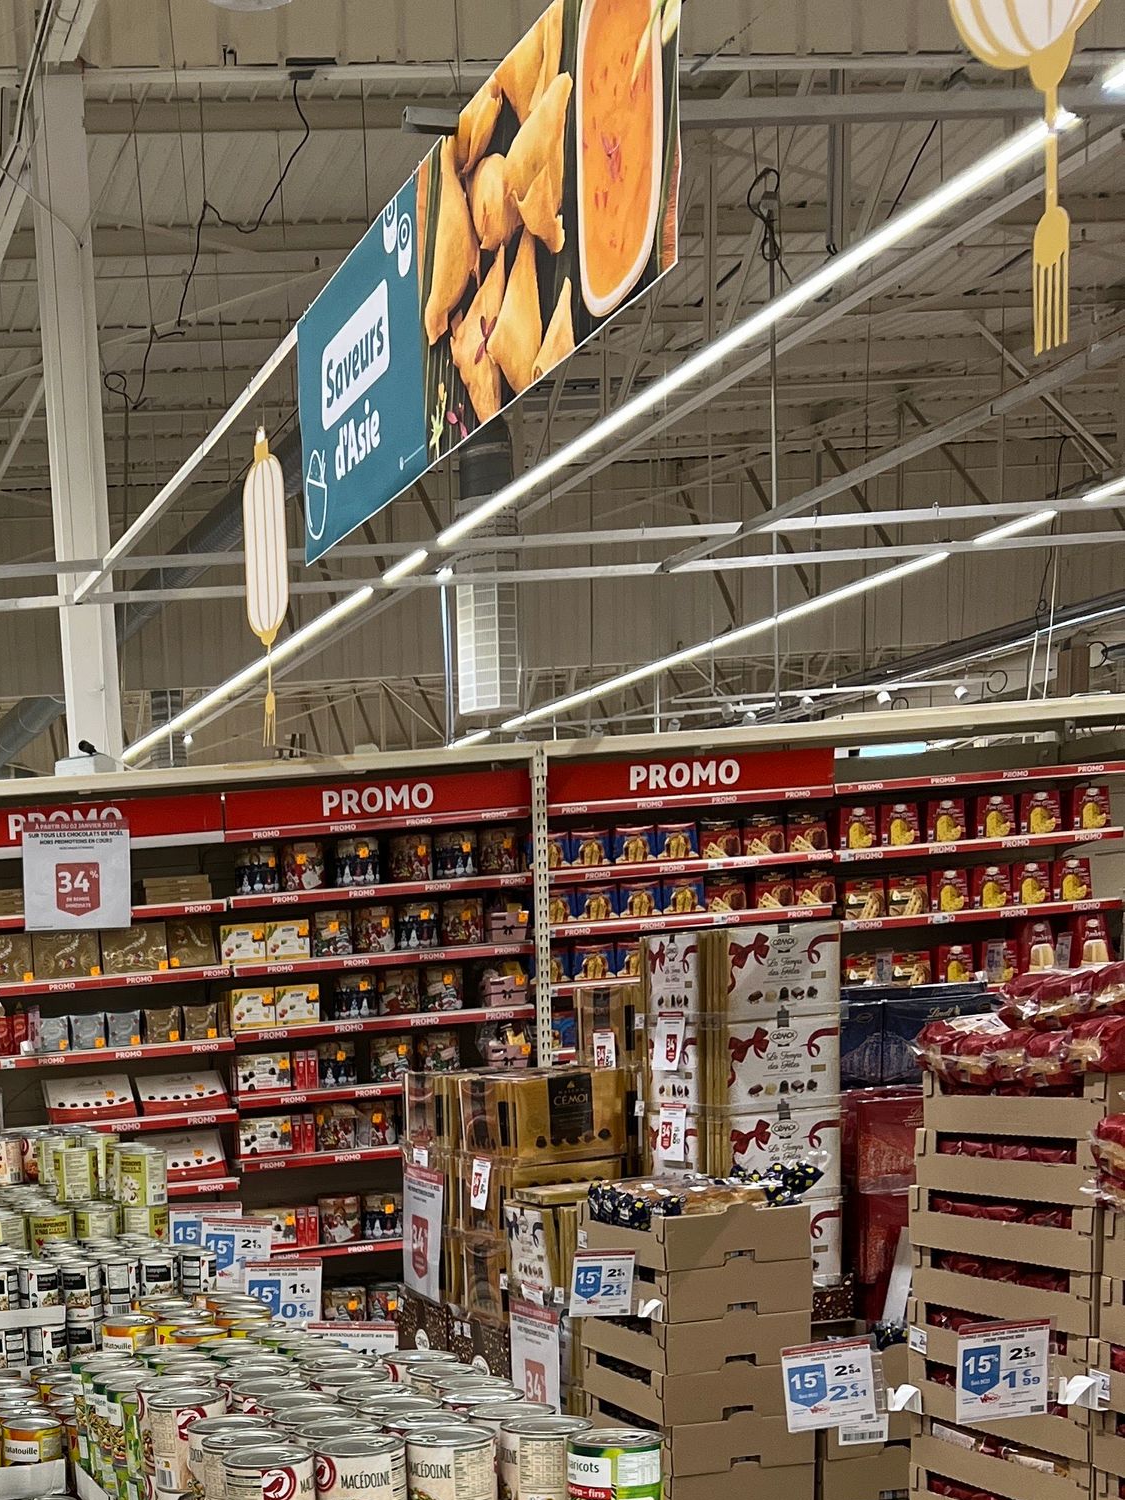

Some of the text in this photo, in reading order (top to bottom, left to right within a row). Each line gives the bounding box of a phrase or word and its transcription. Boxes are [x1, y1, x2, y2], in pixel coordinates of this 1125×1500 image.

[325, 316, 384, 409] Saveurs
[334, 399, 381, 481] d'Asie
[628, 758, 742, 792] PROMO
[321, 782, 435, 817] PROMO
[340, 1469, 391, 1490] MACÉDOINE
